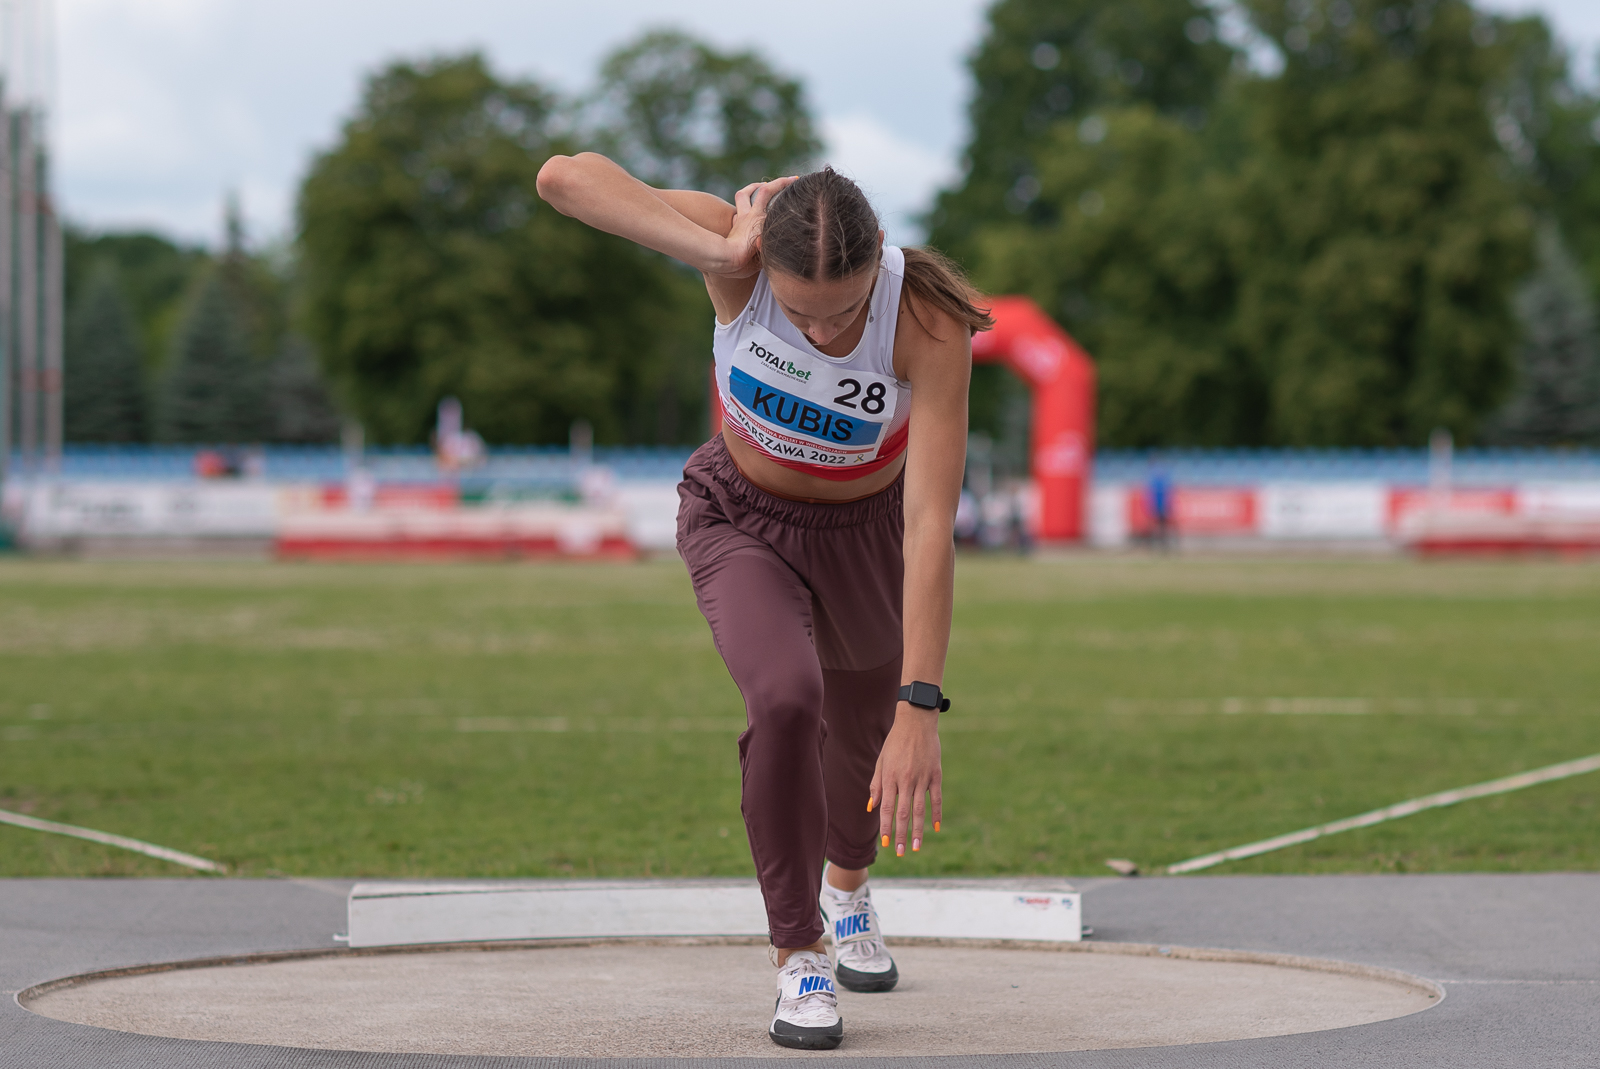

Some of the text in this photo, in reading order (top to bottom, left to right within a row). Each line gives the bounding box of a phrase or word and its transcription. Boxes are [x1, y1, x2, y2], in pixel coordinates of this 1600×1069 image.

[749, 341, 812, 381] TOTALbet
[752, 386, 855, 442] KUBIS
[833, 378, 887, 415] 28
[736, 409, 846, 464] WARSZAWA 2022
[778, 434, 798, 444] POLSKI
[835, 912, 871, 941] NIKE
